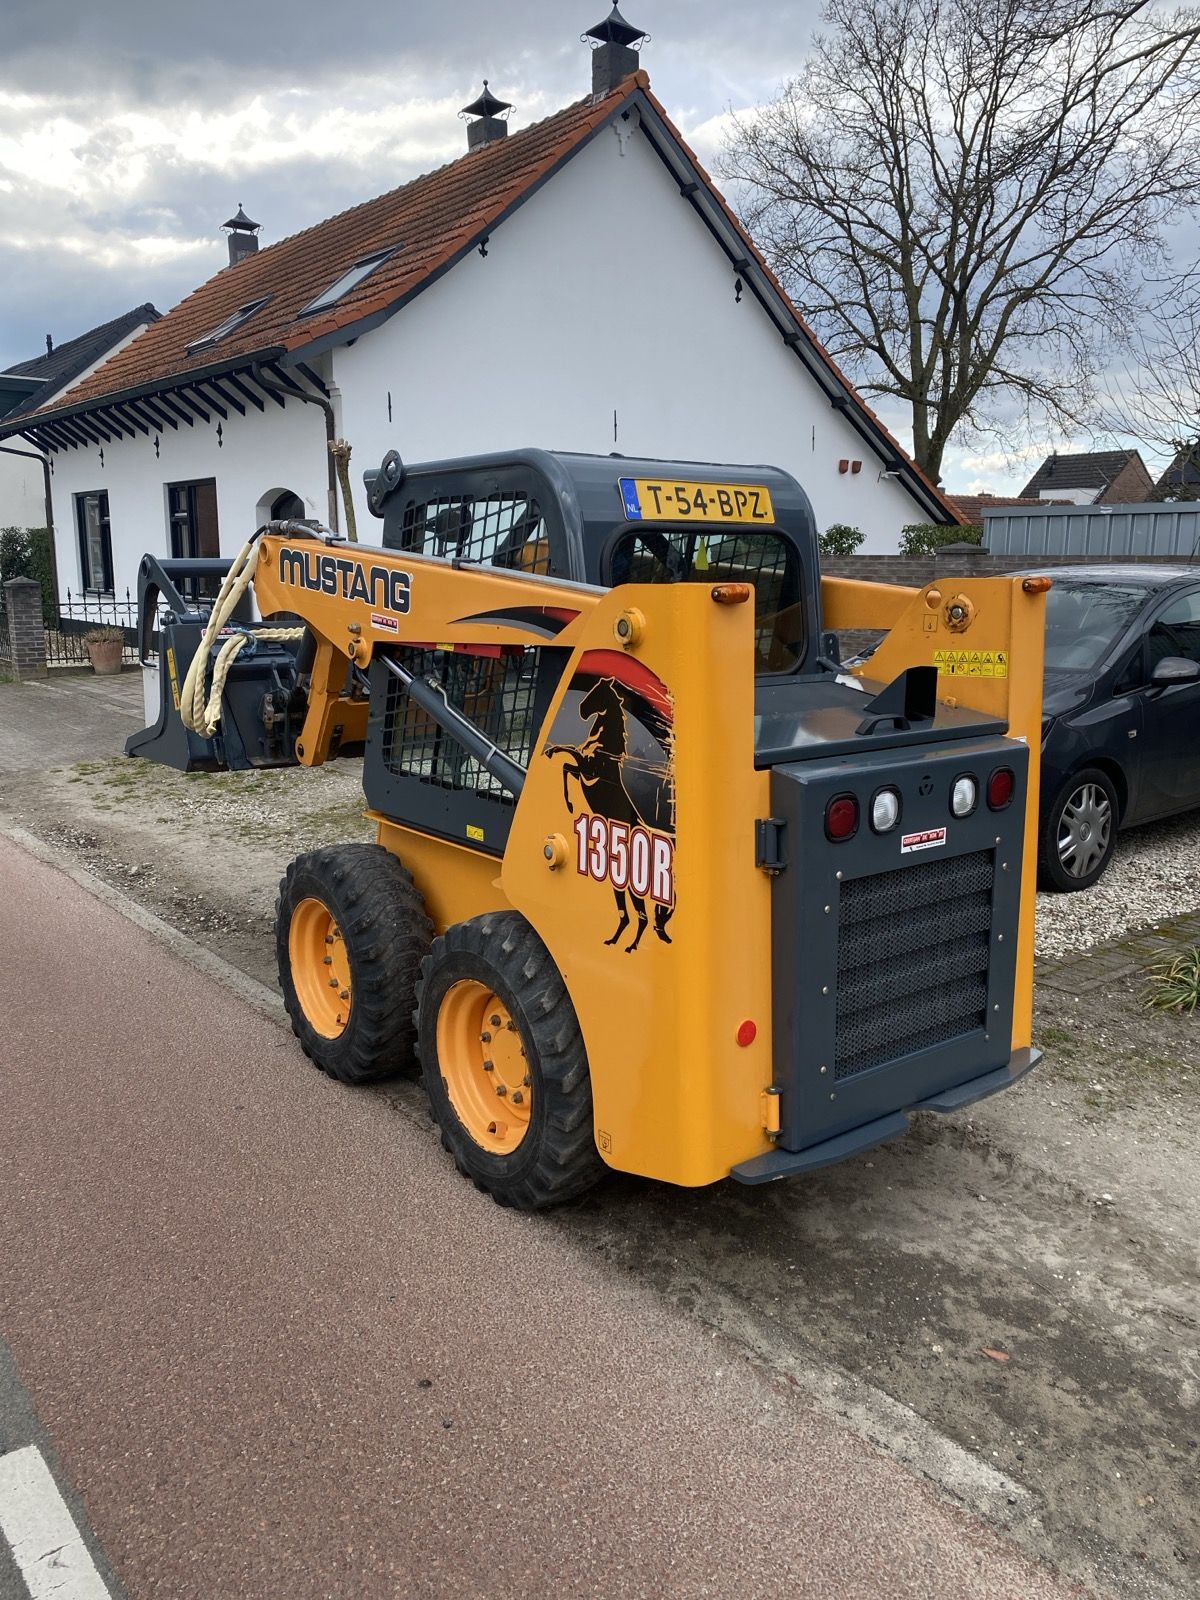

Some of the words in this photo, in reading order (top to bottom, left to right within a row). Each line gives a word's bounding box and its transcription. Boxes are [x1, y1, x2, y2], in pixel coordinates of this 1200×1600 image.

[627, 503, 639, 513] NL
[646, 485, 765, 519] T-54-BPZ
[279, 547, 411, 614] MUSTANG
[574, 813, 674, 906] 1350R
